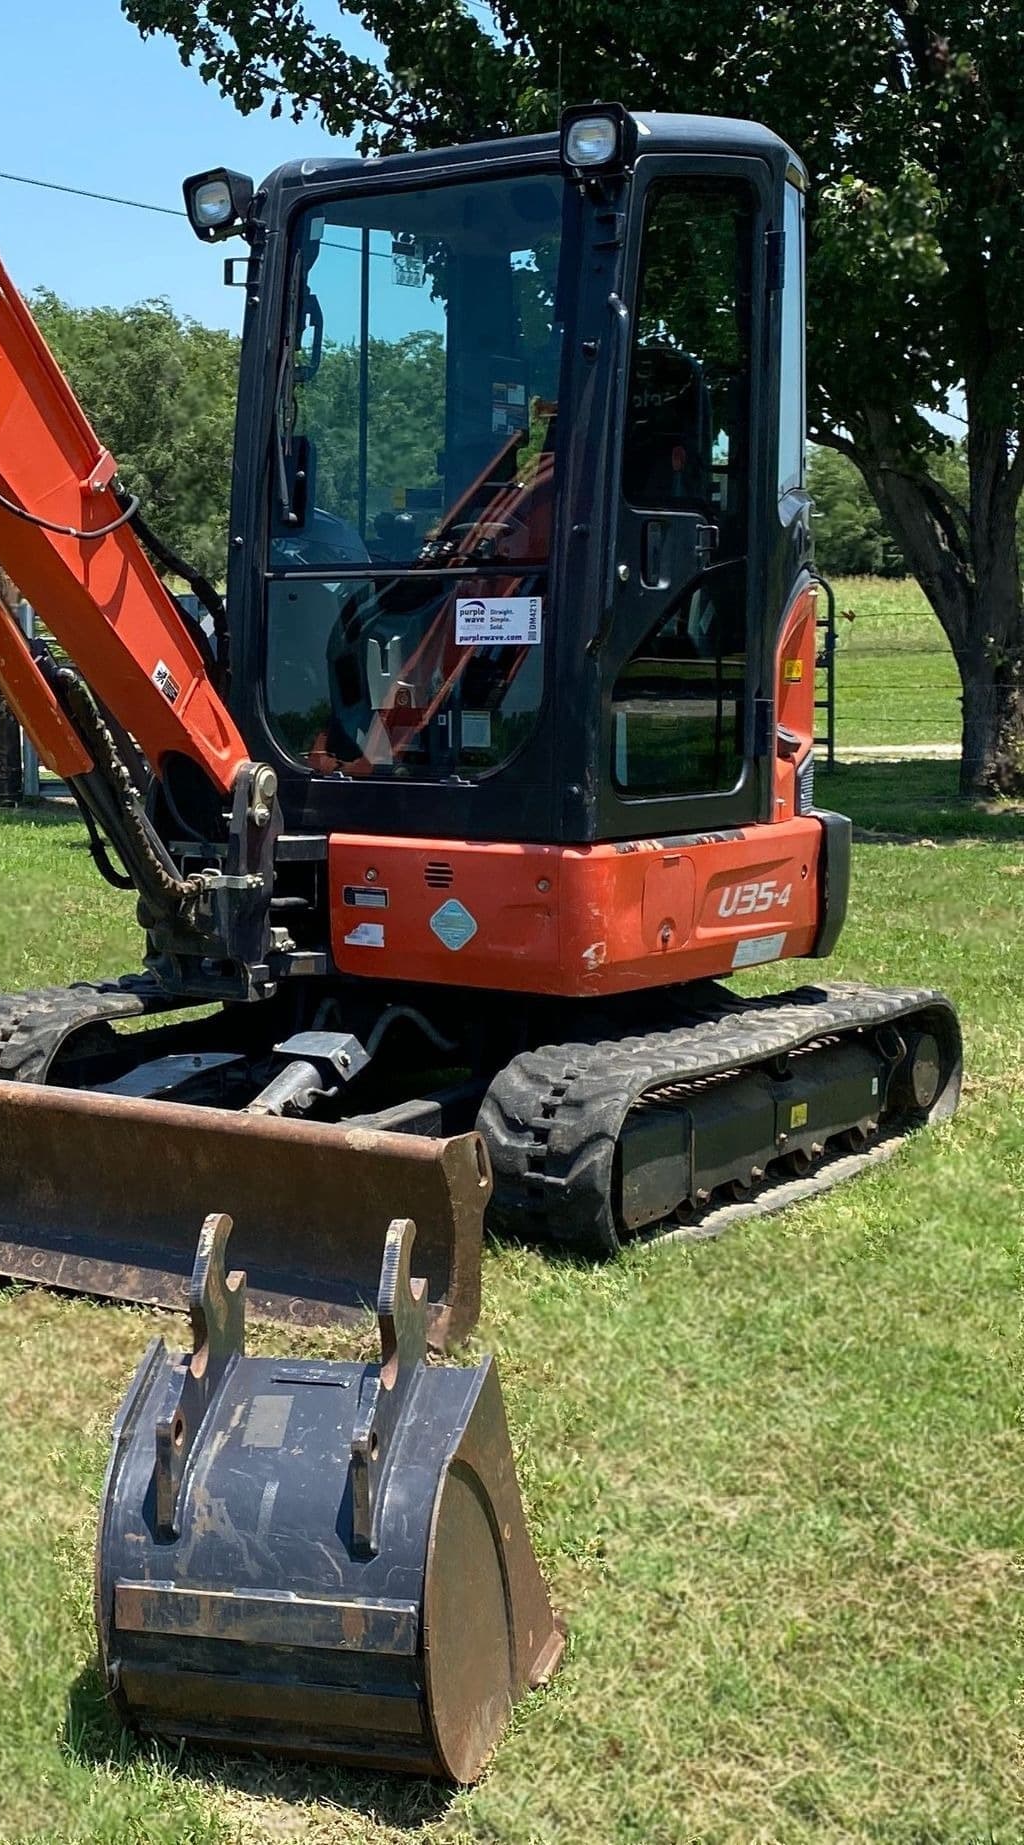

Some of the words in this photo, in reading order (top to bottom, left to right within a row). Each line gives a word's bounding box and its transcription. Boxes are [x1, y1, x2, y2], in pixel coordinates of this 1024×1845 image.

[459, 608, 485, 617] purple
[529, 599, 537, 630] DM4213
[459, 634, 522, 642] purplewave.com
[718, 880, 793, 918] U35-4
